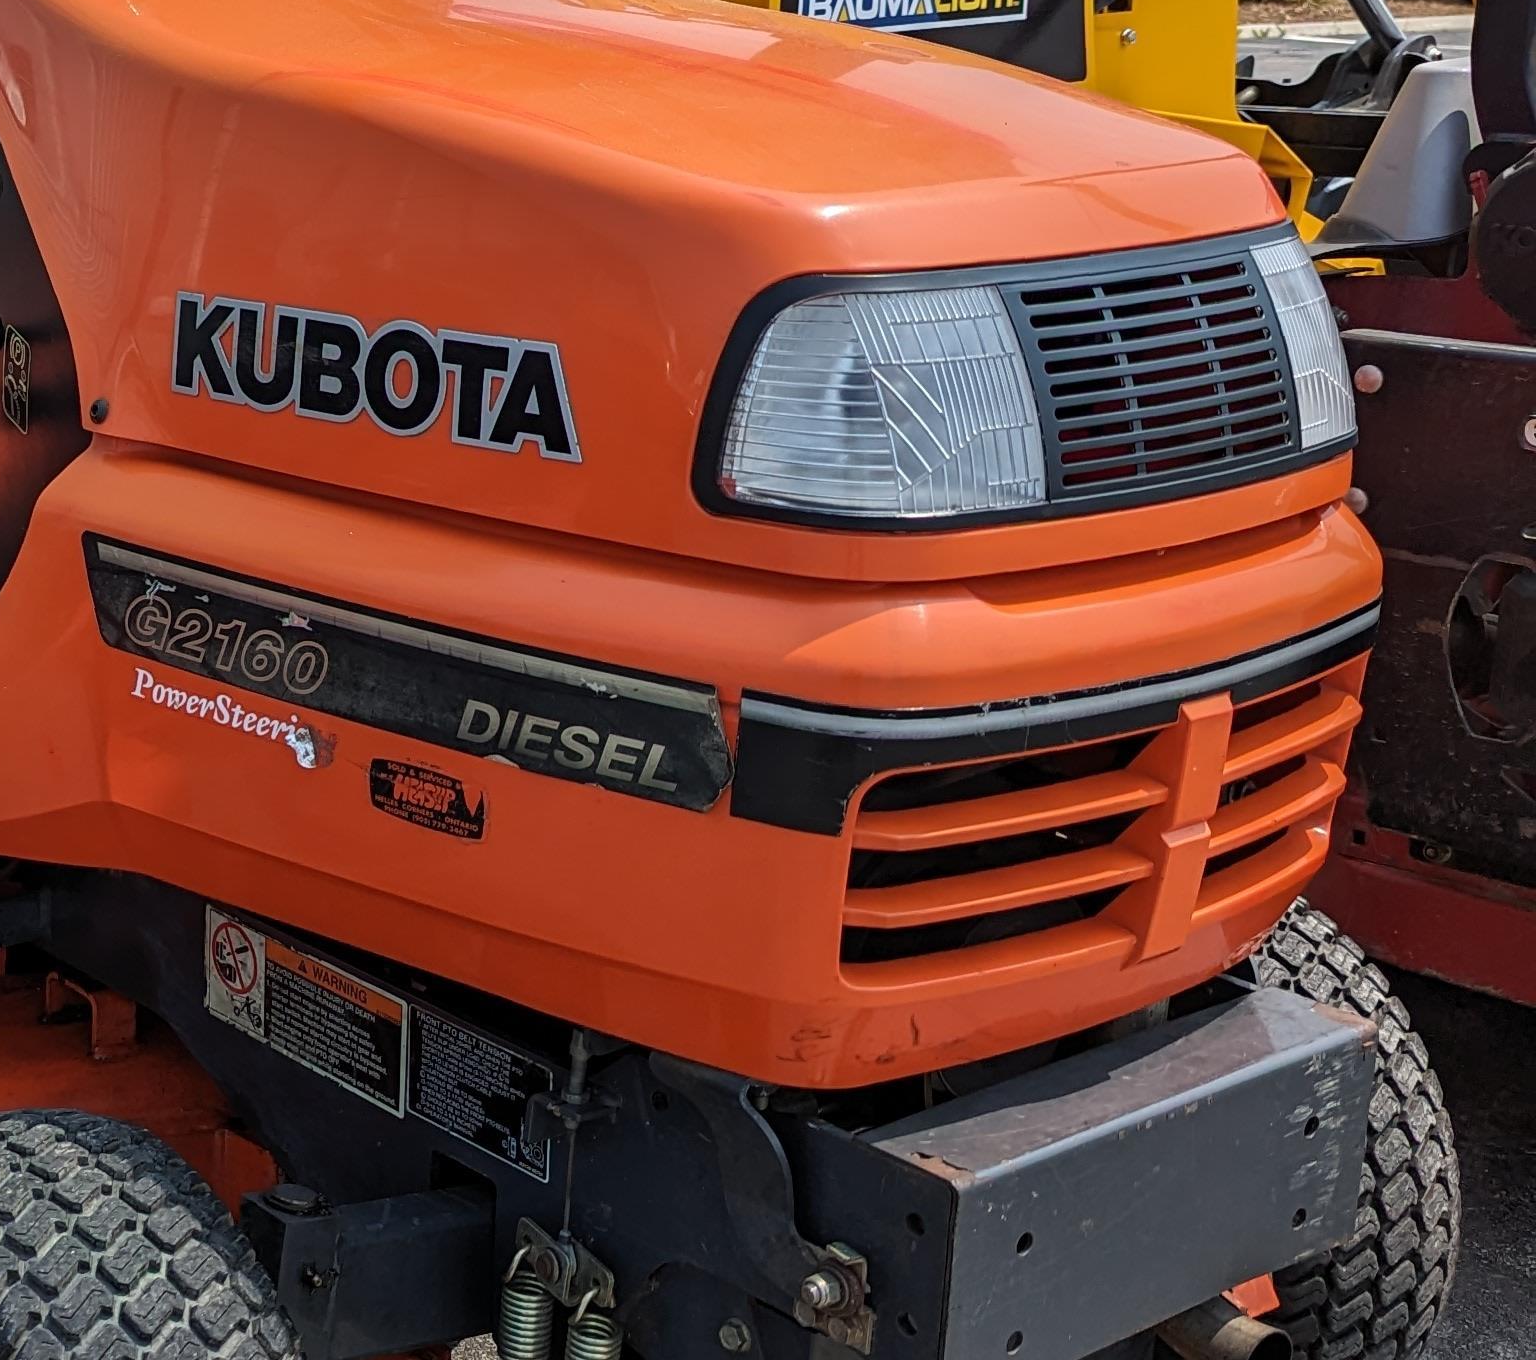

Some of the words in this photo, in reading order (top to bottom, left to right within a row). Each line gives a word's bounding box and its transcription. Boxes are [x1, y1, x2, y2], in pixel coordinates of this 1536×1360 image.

[172, 291, 583, 463] KUBOTA
[125, 595, 329, 695] G2160
[456, 699, 678, 792] DIESEL
[387, 763, 407, 773] SOLD
[419, 771, 453, 788] SERVICED
[444, 816, 479, 832] ONTARIO
[312, 964, 368, 1005] WARNING
[416, 1009, 439, 1029] FRONT
[442, 1022, 456, 1037] PTO
[458, 1030, 476, 1047] BELT
[479, 1040, 511, 1064] TENSION
